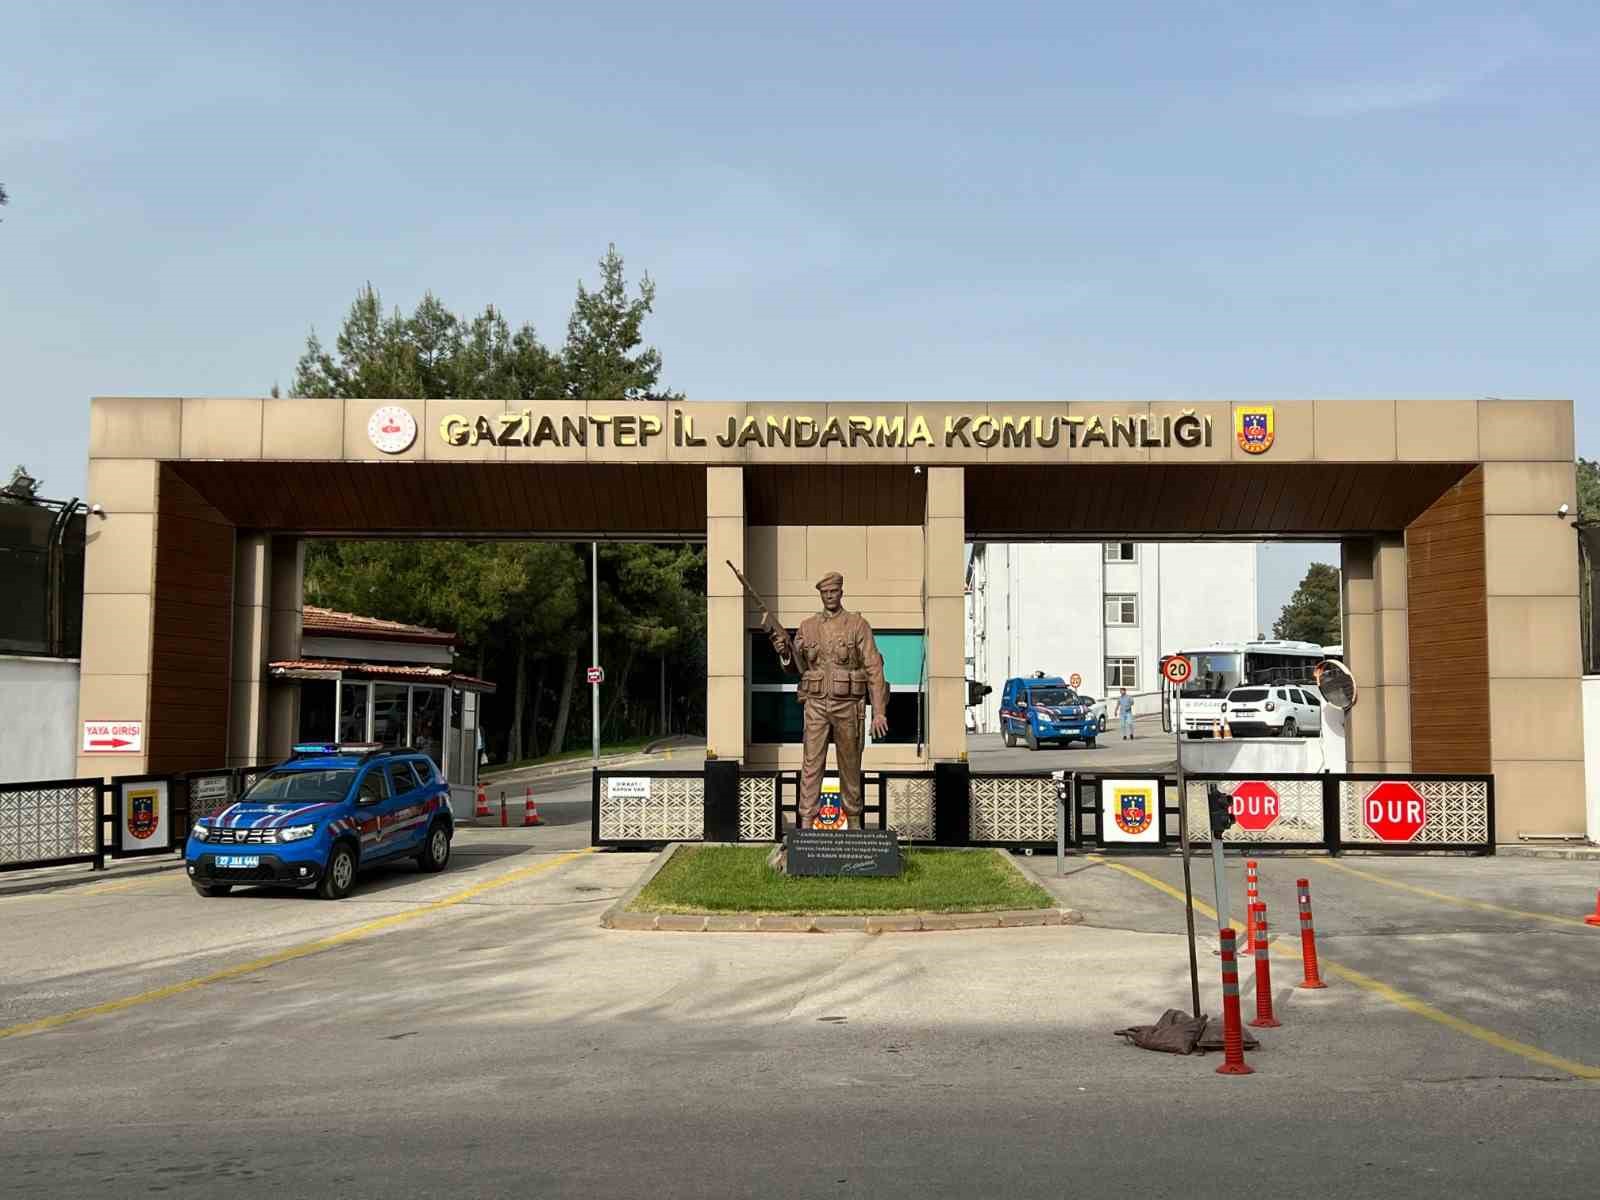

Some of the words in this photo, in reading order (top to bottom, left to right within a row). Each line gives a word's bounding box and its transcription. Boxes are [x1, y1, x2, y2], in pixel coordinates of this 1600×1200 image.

[439, 408, 663, 447] GAZİANTEP
[674, 408, 707, 447] İL
[716, 415, 935, 448] JANDARMA
[945, 408, 1213, 448] KOMUTANLIĞI
[1169, 663, 1187, 677] 20
[86, 726, 109, 736] YAYA
[1233, 796, 1276, 816] DUR
[1369, 800, 1421, 824] DUR
